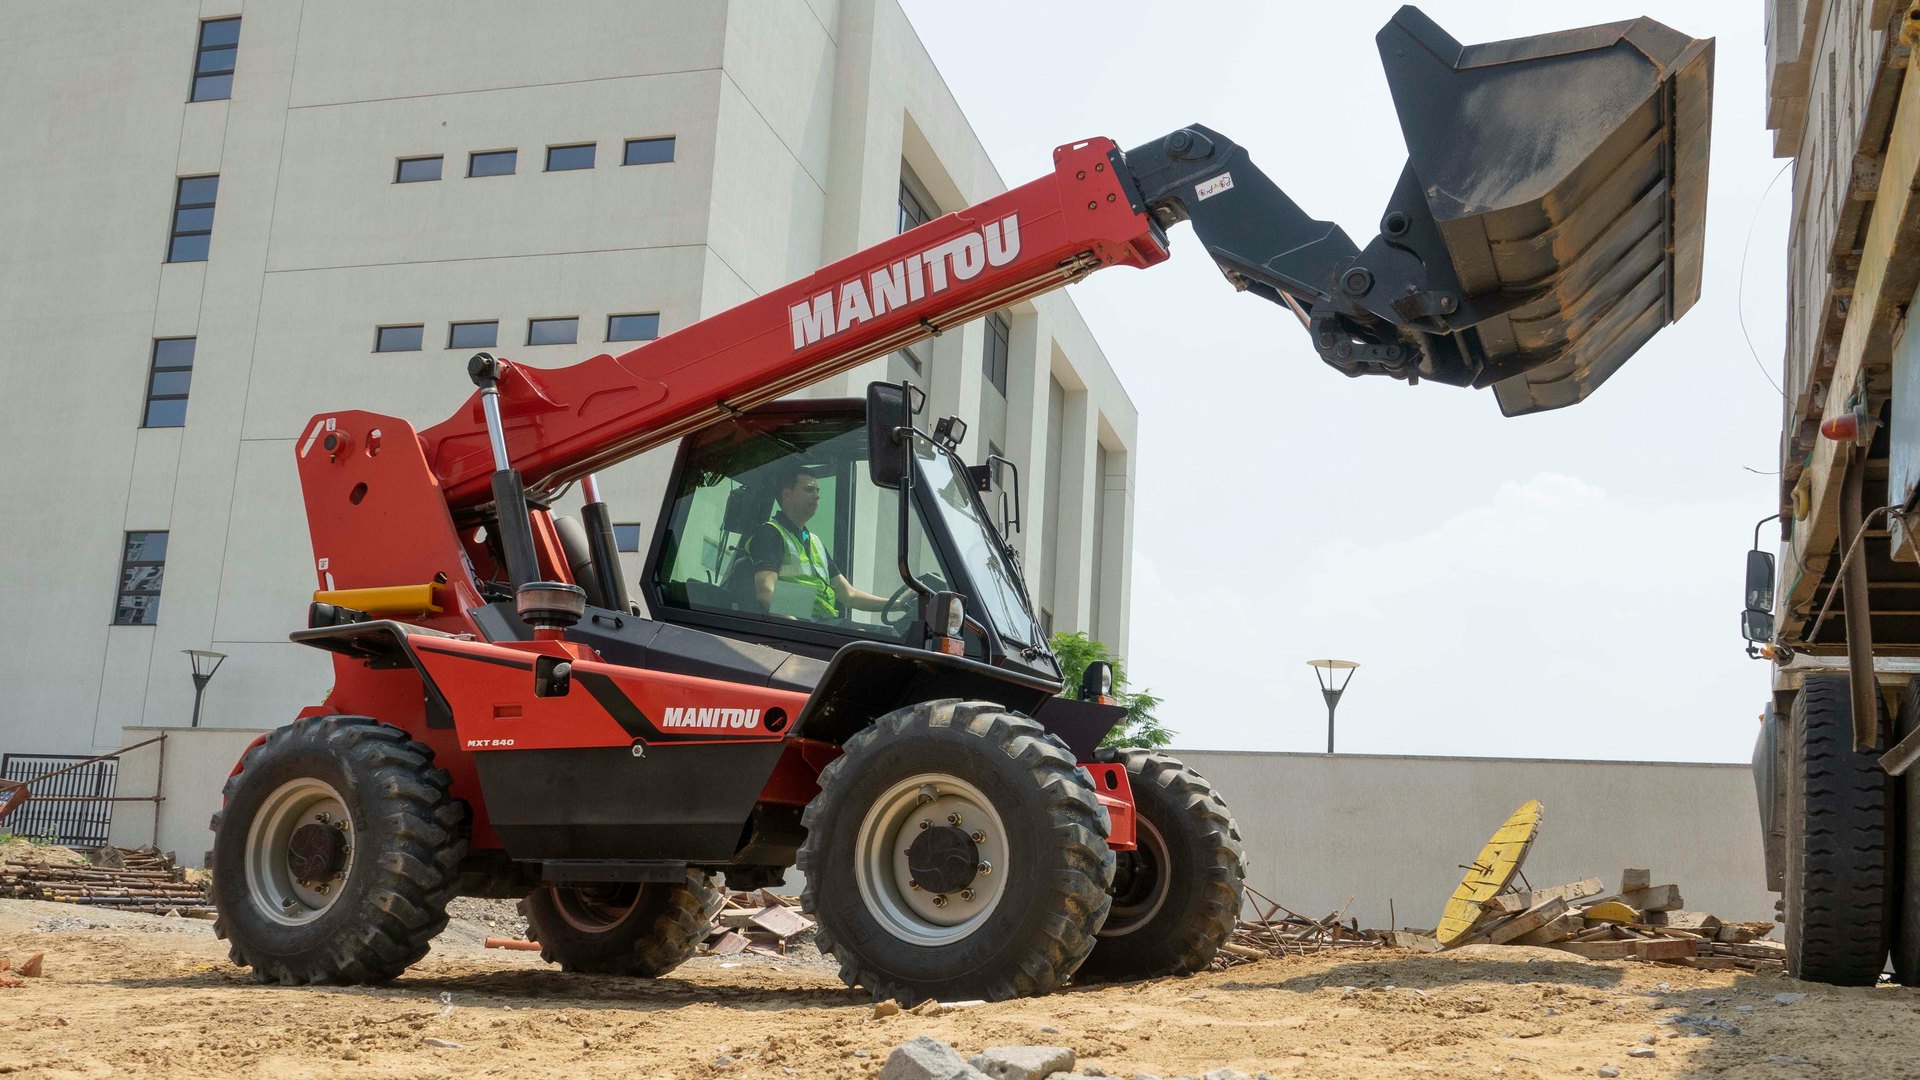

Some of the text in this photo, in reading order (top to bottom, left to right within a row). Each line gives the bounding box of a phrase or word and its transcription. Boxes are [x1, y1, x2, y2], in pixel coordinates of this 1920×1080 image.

[790, 212, 1021, 351] MANITOU
[662, 707, 761, 729] MANITOU
[467, 739, 490, 747] MXT
